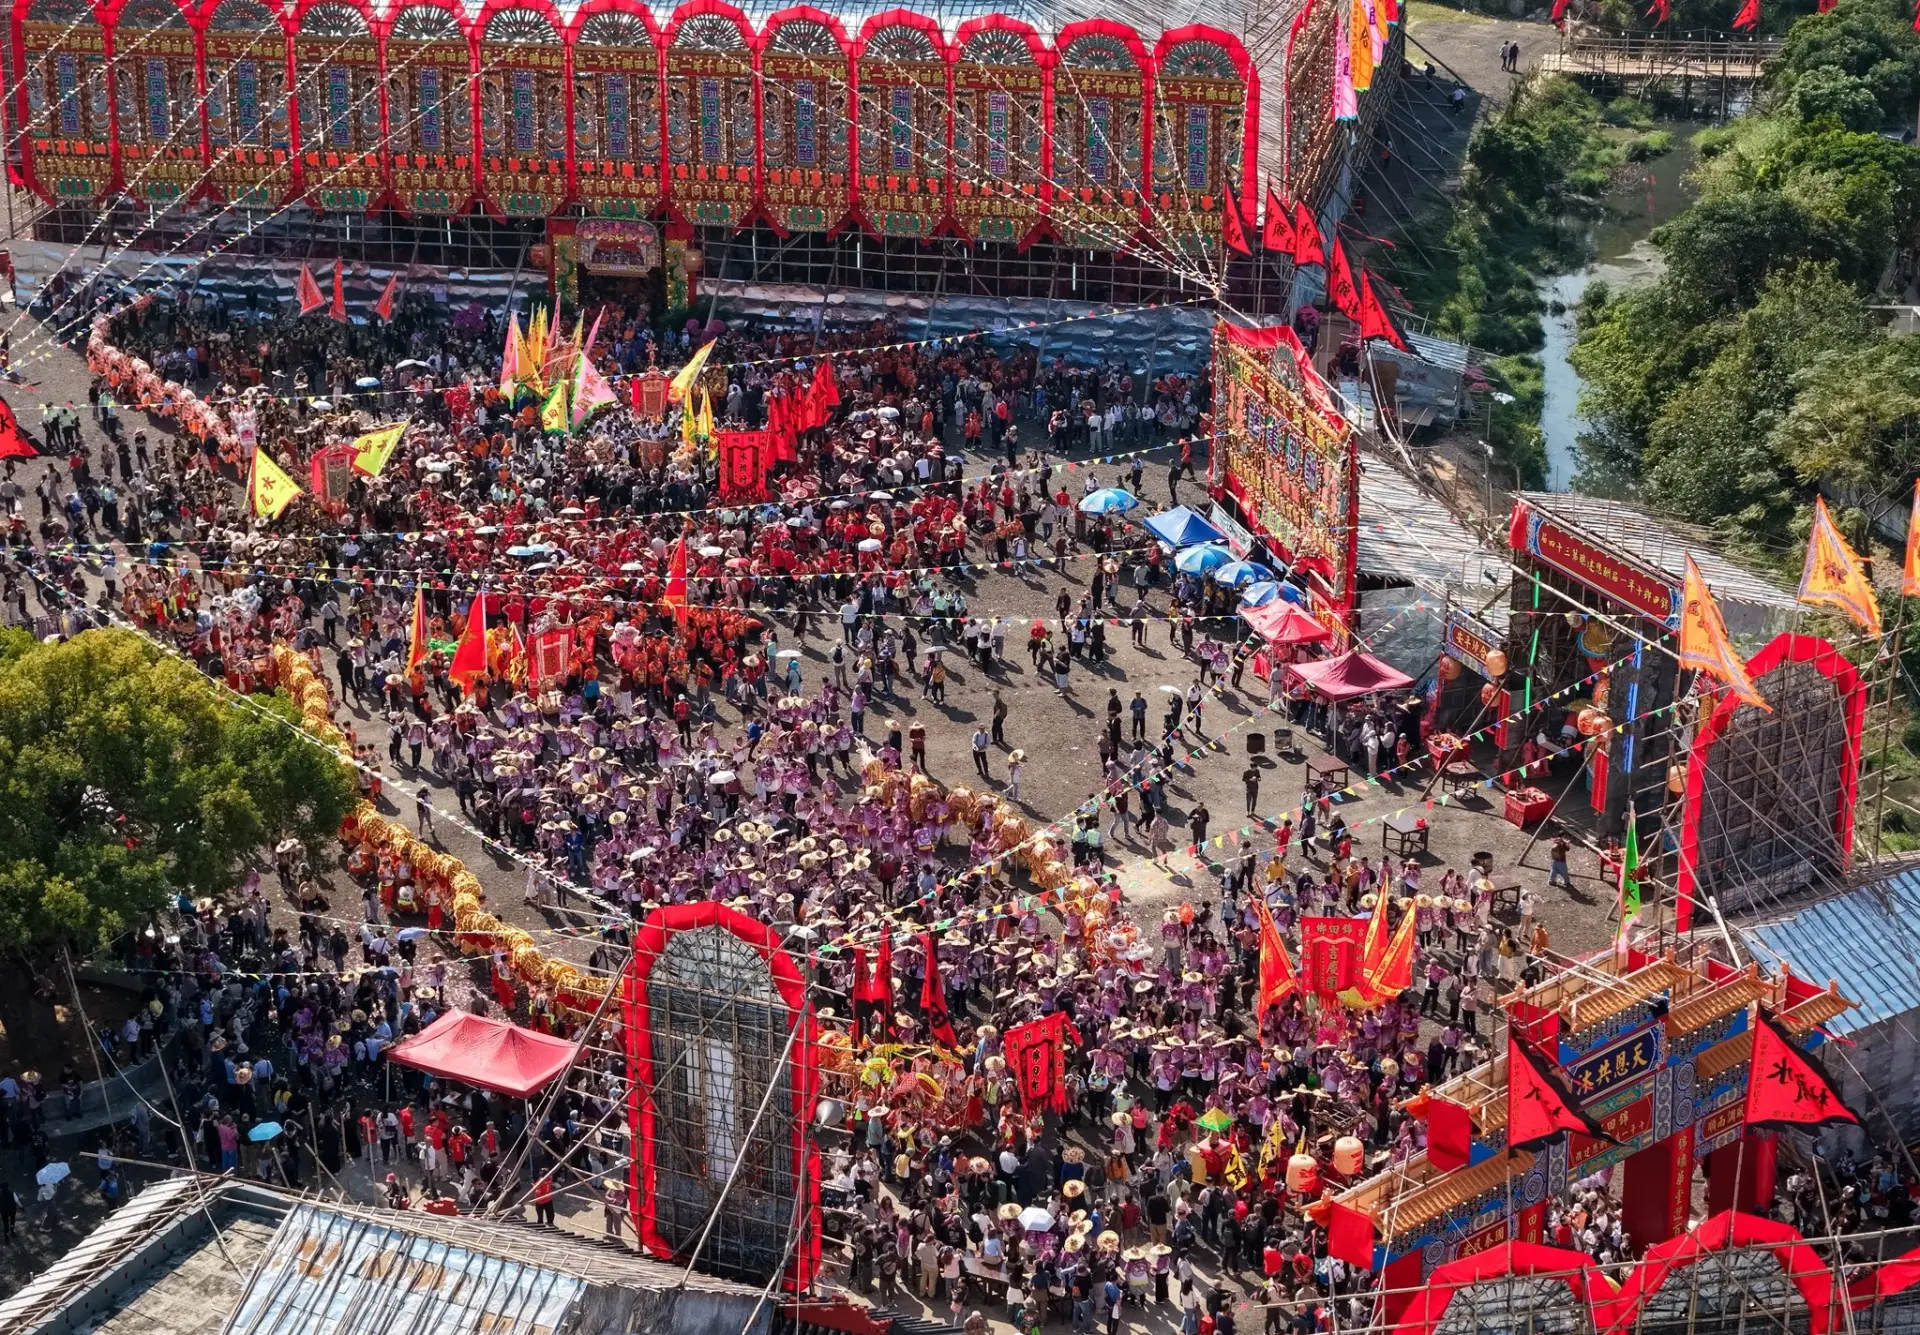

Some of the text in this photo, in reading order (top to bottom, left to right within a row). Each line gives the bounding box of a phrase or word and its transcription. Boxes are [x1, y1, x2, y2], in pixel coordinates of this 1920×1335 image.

[1326, 945, 1339, 990] 吉慶圍
[1576, 1042, 1648, 1096] 天恩共沐
